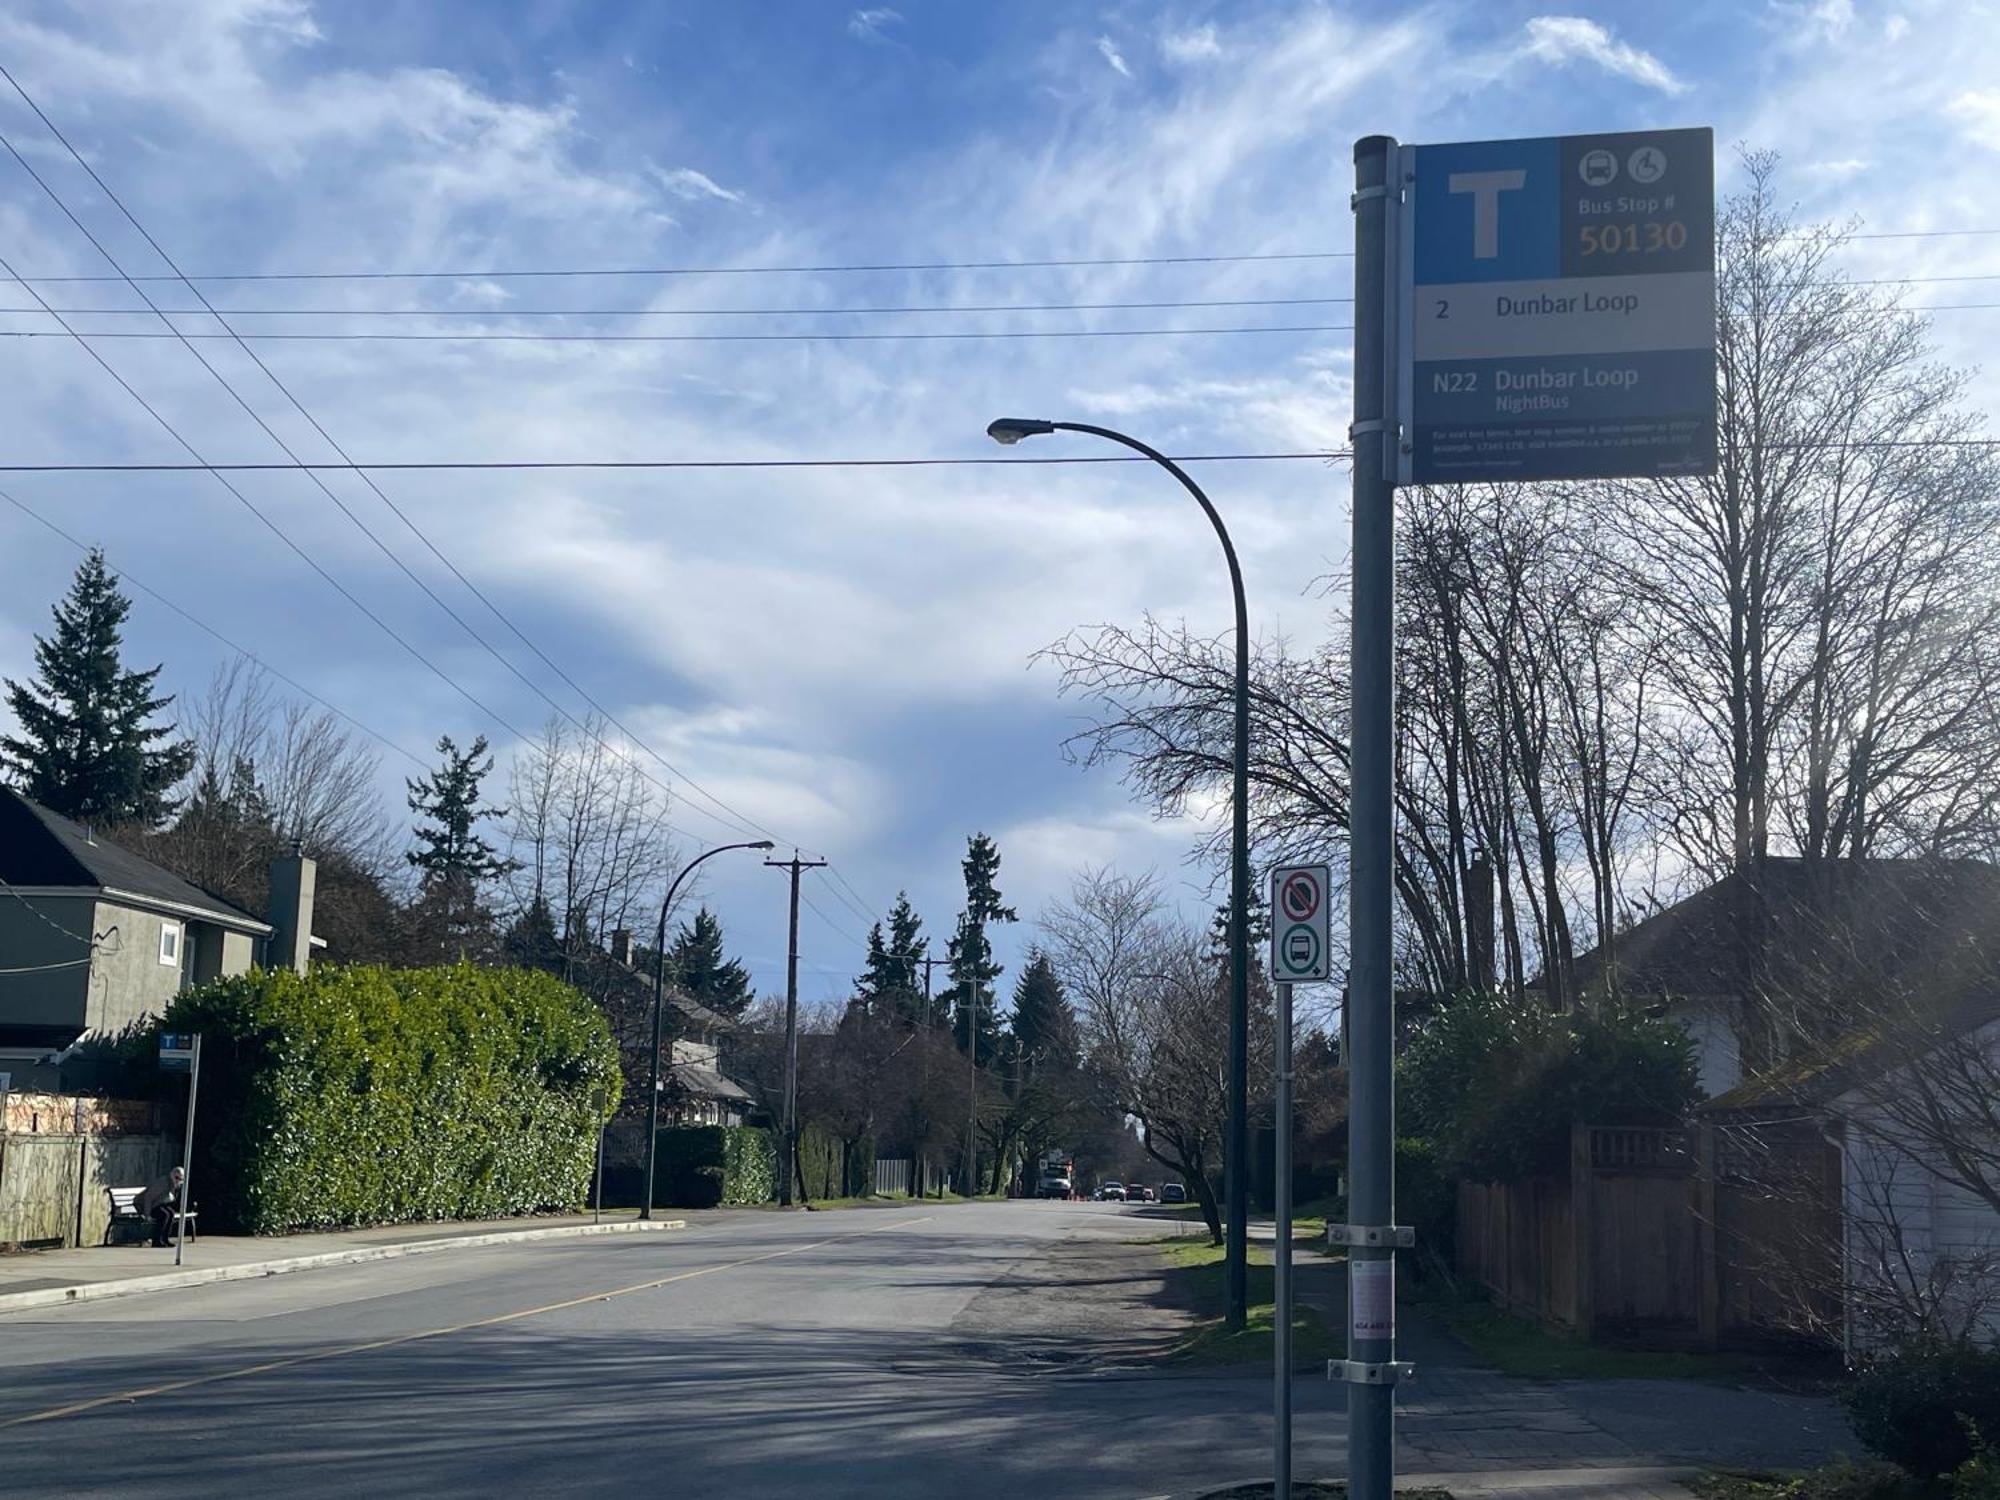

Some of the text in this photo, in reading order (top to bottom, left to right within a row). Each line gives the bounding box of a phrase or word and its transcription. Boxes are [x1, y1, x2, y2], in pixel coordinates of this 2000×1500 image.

[1449, 169, 1527, 259] T
[1578, 193, 1675, 215] Bus Stop #
[1579, 221, 1687, 257] 50130
[1435, 292, 1639, 319] 2 Dunbar Loop
[1433, 367, 1639, 393] N22 Dunbar Loop
[1495, 394, 1570, 414] NightBus
